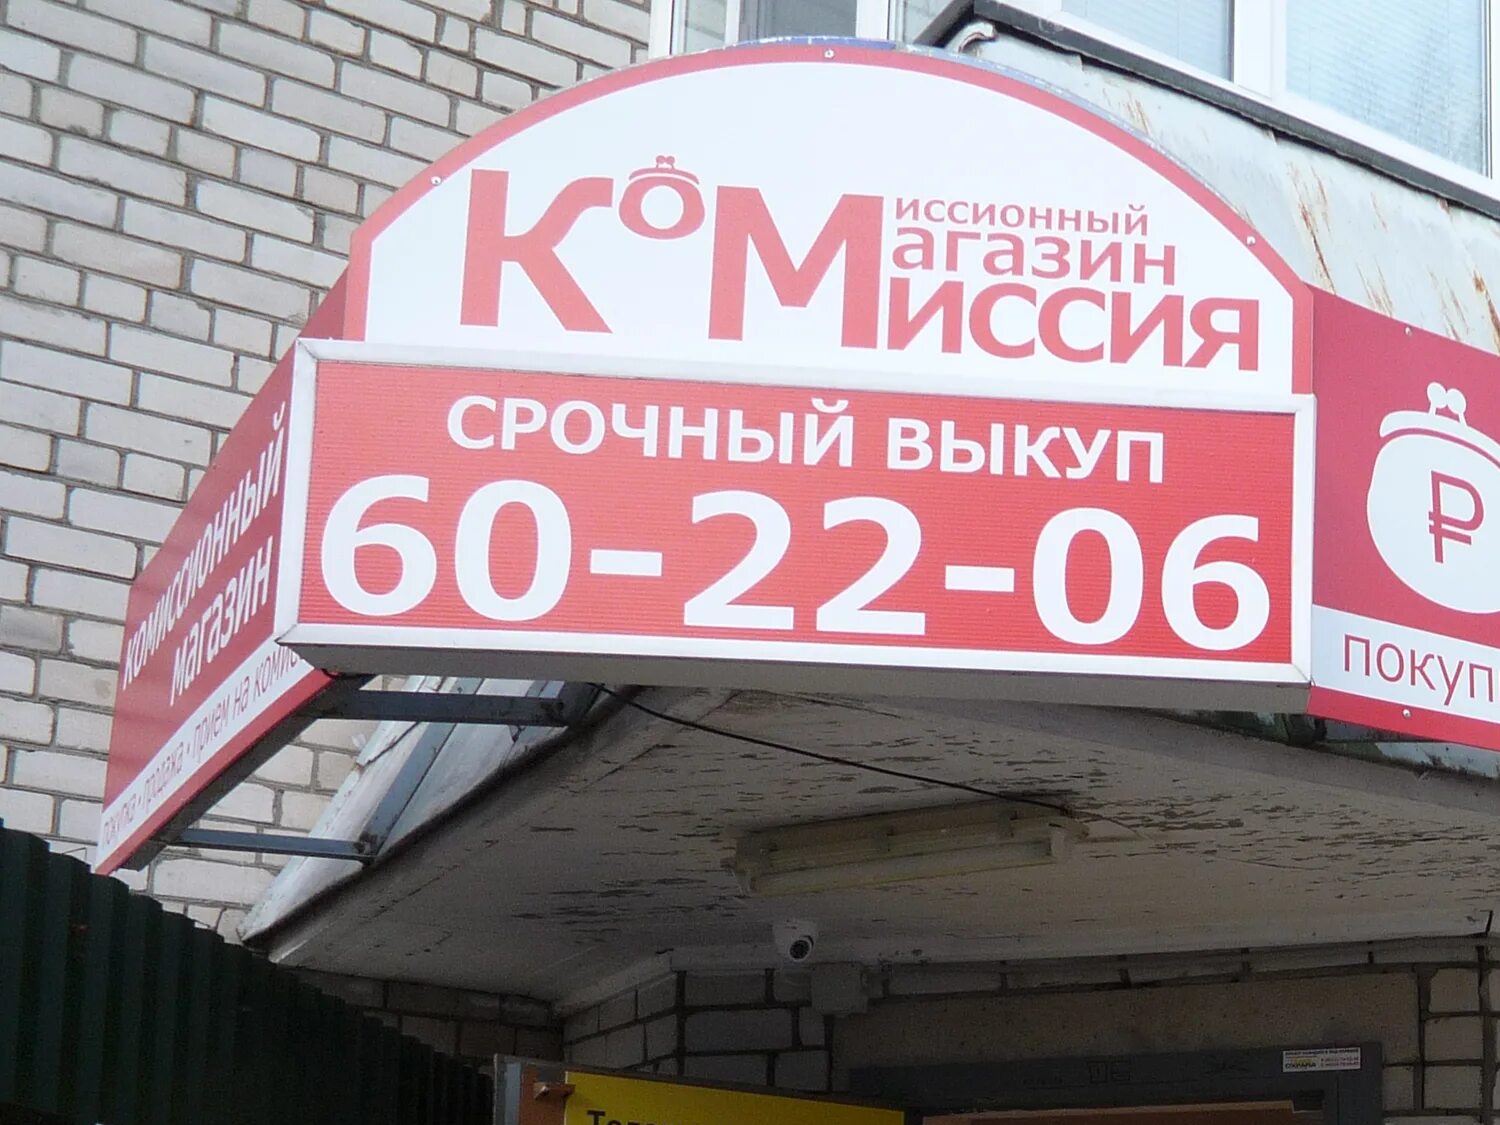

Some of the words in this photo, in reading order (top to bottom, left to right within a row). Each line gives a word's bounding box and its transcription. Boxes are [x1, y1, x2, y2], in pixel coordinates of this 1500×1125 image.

[895, 198, 1149, 236] иссионный
[447, 395, 854, 467] СРОЧНЫЙ
[887, 417, 1164, 484] ВЫКУП
[122, 402, 287, 691] комиссионный
[319, 473, 1270, 651] 60-22-06
[169, 535, 274, 707] магазин
[233, 675, 251, 721] на
